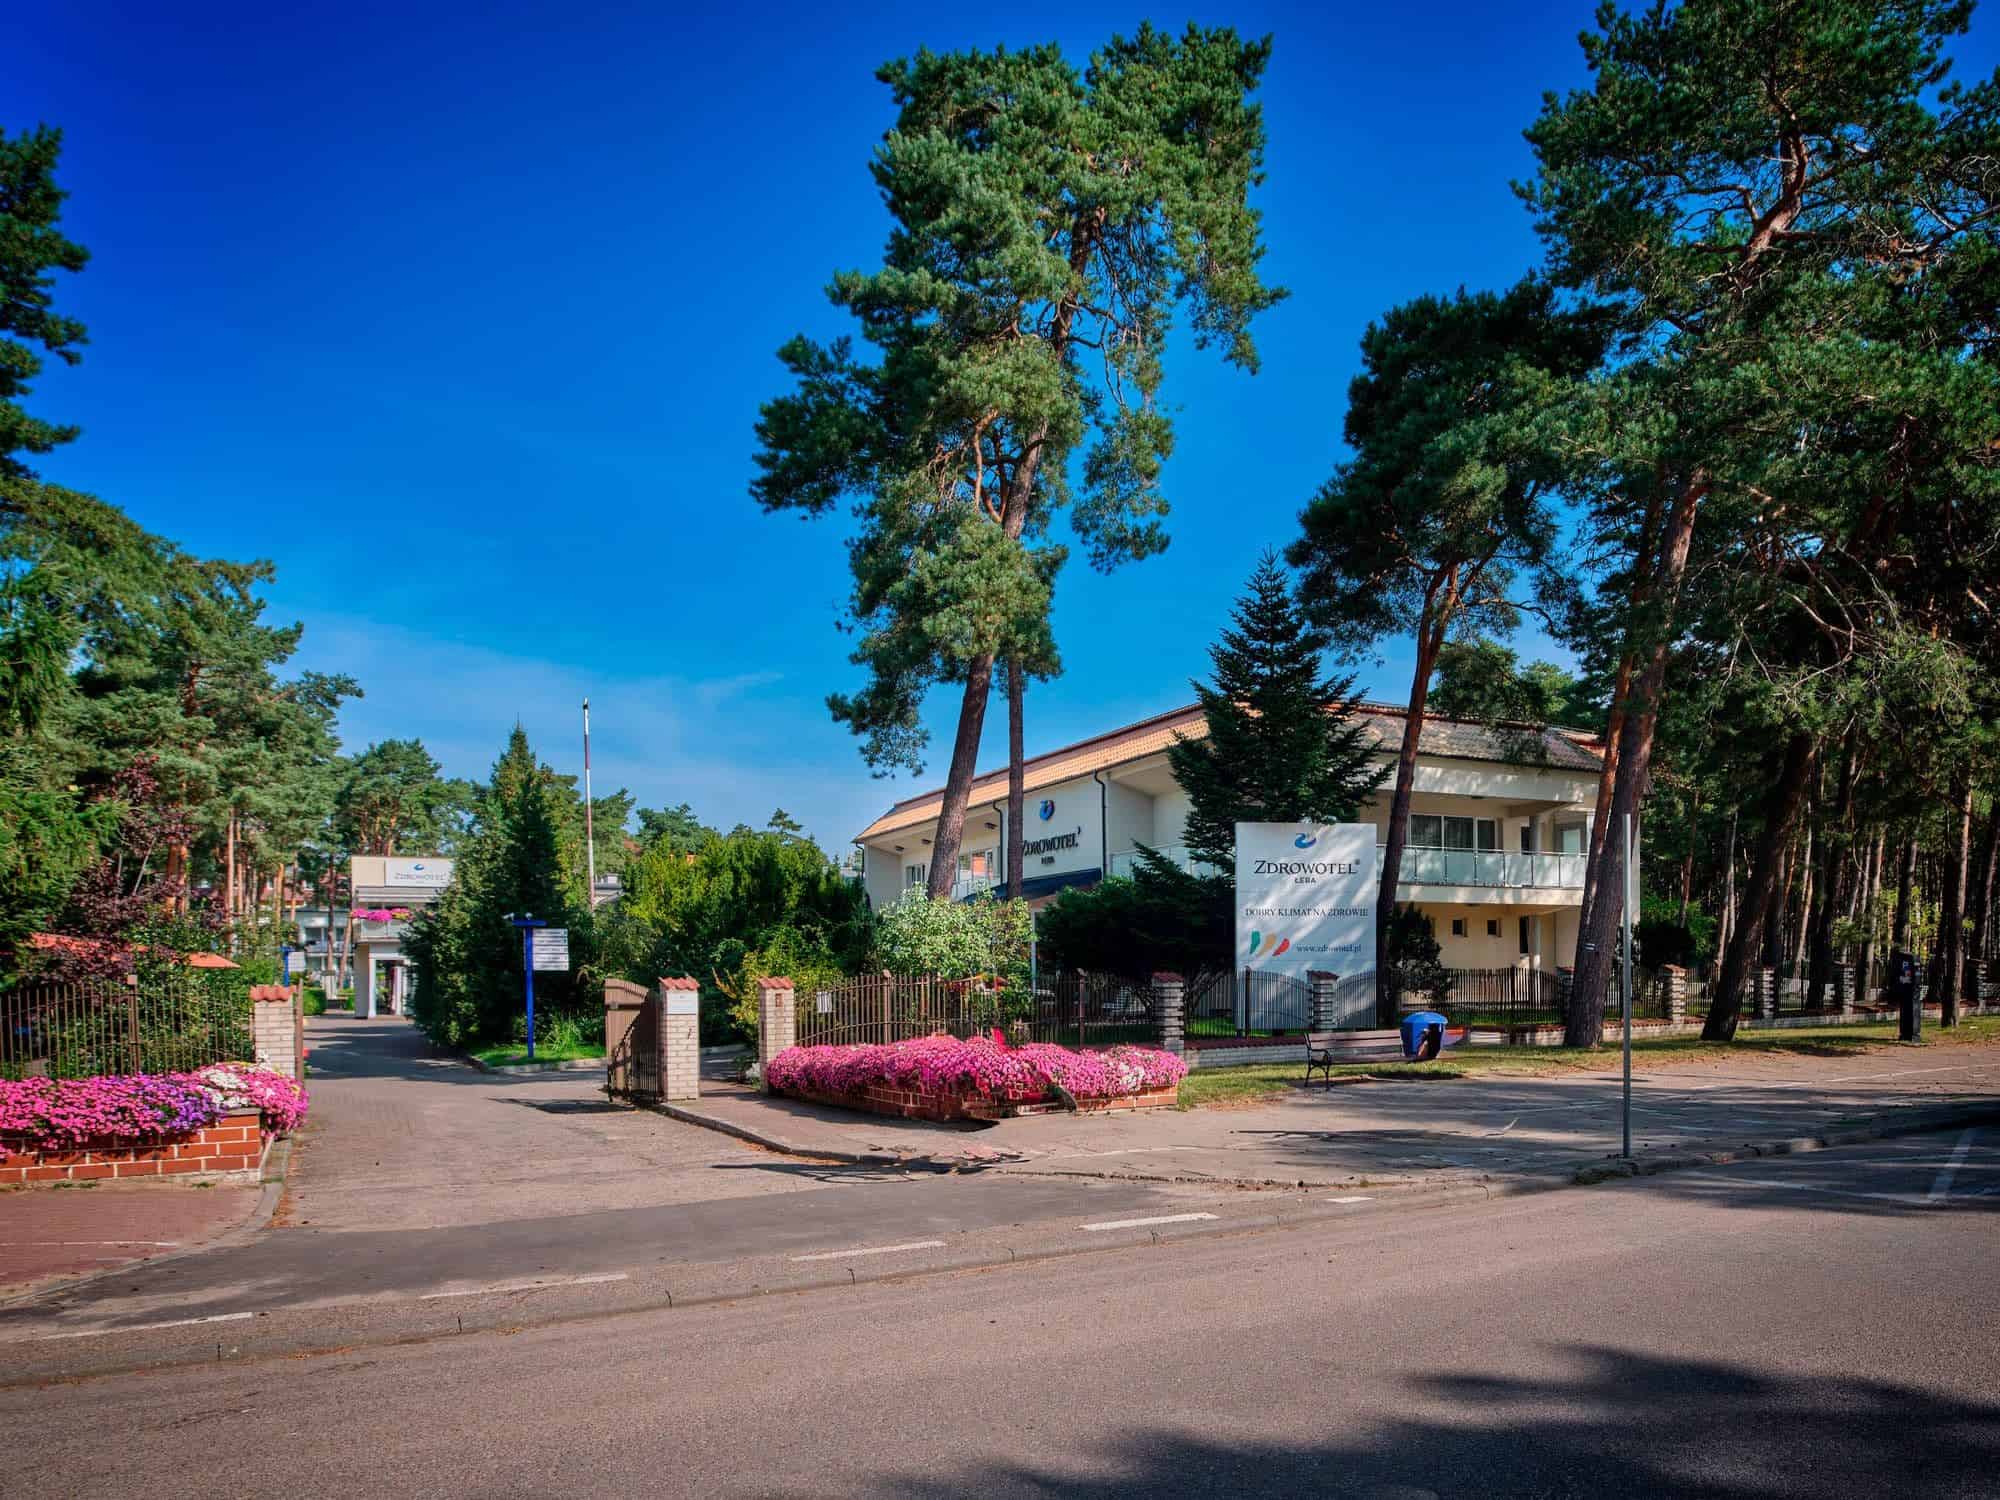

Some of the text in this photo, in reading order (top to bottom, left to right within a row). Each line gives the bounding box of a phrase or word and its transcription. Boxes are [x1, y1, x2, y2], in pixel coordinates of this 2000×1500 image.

[1254, 860, 1357, 875] ZDROWOTEL
[1246, 908, 1369, 917] DOBRY KLIMAT NA ZDROWIE
